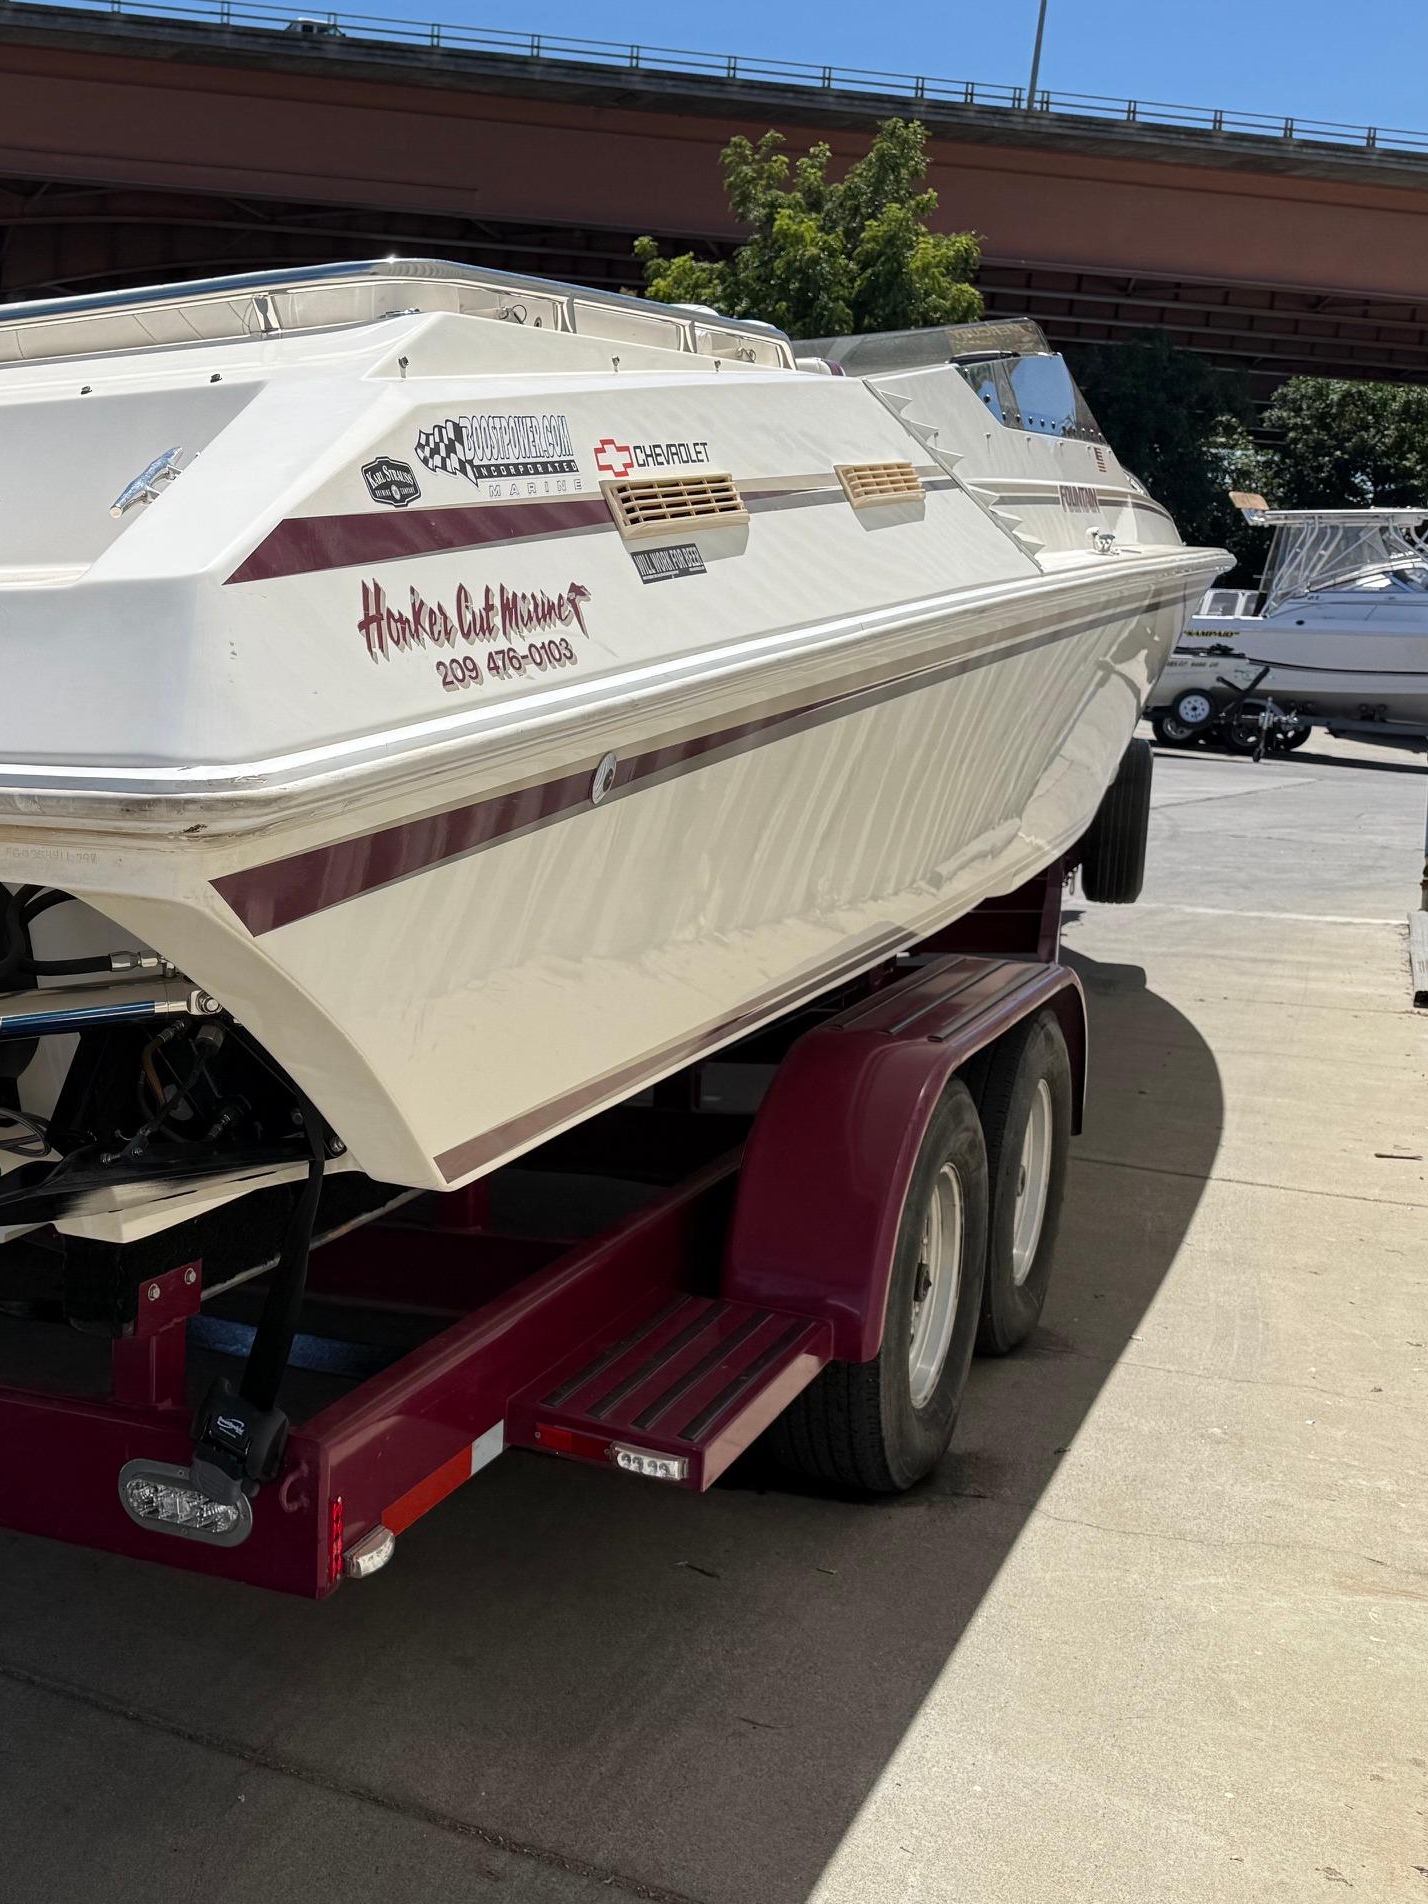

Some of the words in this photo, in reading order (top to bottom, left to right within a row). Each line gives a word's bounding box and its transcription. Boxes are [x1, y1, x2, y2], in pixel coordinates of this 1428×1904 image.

[459, 415, 574, 461] BOOSTPOWER.COM
[633, 442, 710, 467] CHEVROLET
[366, 471, 387, 489] KARL
[382, 465, 414, 485] STRAUSS
[474, 461, 578, 477] INCORPORATED
[633, 554, 656, 575] WILL
[649, 551, 675, 572] WORK
[669, 549, 687, 569] FOR
[682, 547, 704, 567] BEER
[456, 582, 499, 646] Cut
[436, 654, 484, 692] 209
[487, 637, 578, 681] 476-0103
